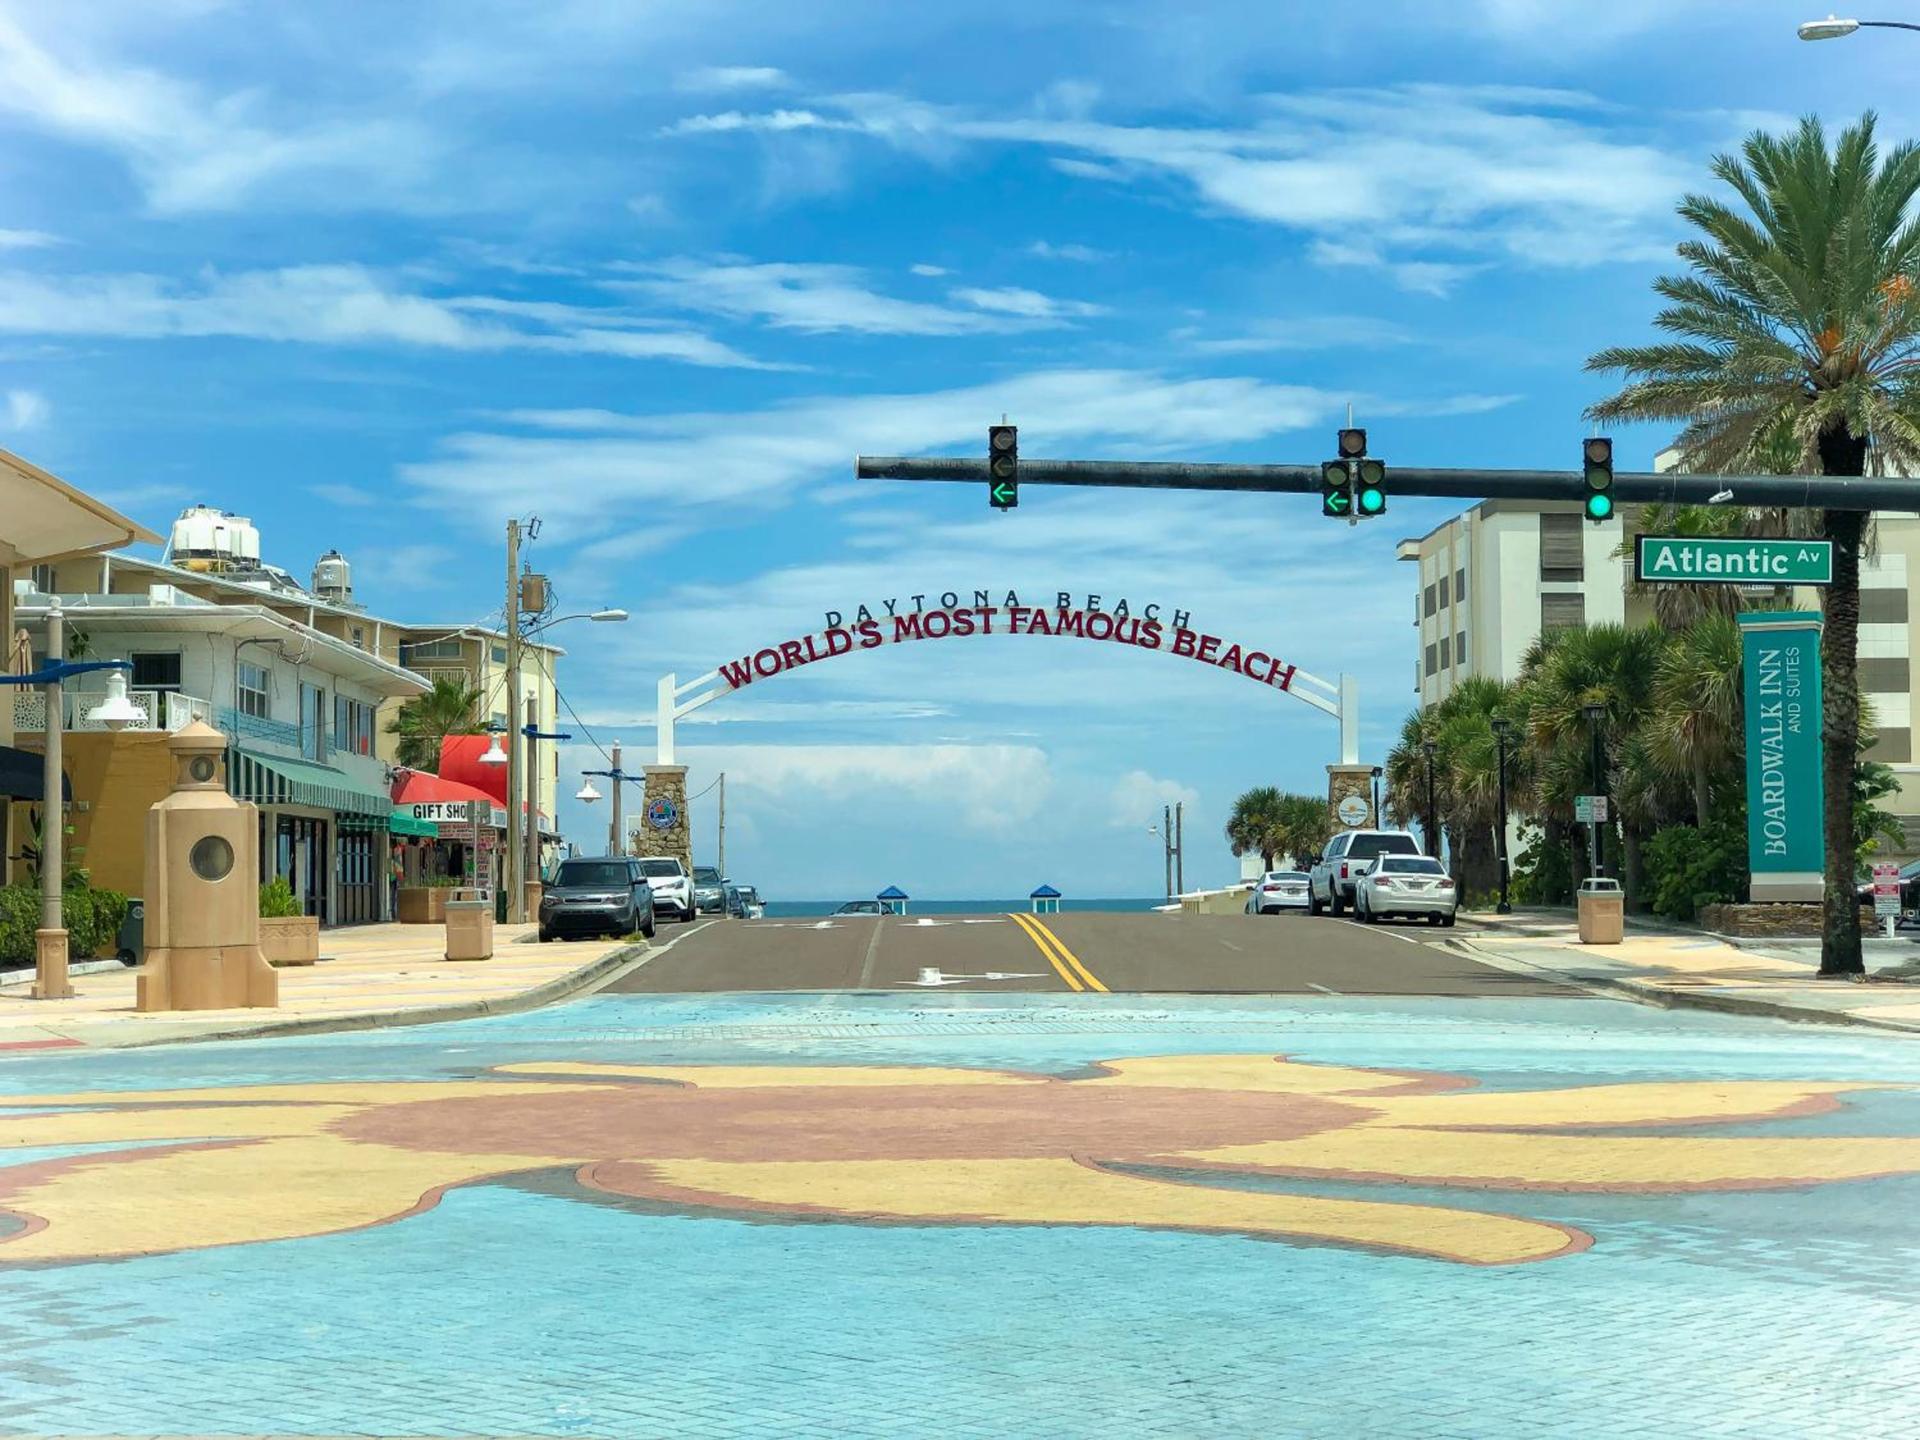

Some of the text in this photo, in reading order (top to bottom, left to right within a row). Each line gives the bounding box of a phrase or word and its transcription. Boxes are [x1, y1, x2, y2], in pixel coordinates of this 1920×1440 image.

[1653, 546, 1820, 575] Atlantic Av
[825, 590, 1190, 629] DAYTONA BEACH
[719, 608, 1297, 692] WORLD'S MOST FAMOUS BEACH
[1786, 647, 1801, 733] AND SUITES
[1759, 649, 1787, 855] BOARDWALK INN
[413, 804, 468, 819] GIFT SHO
